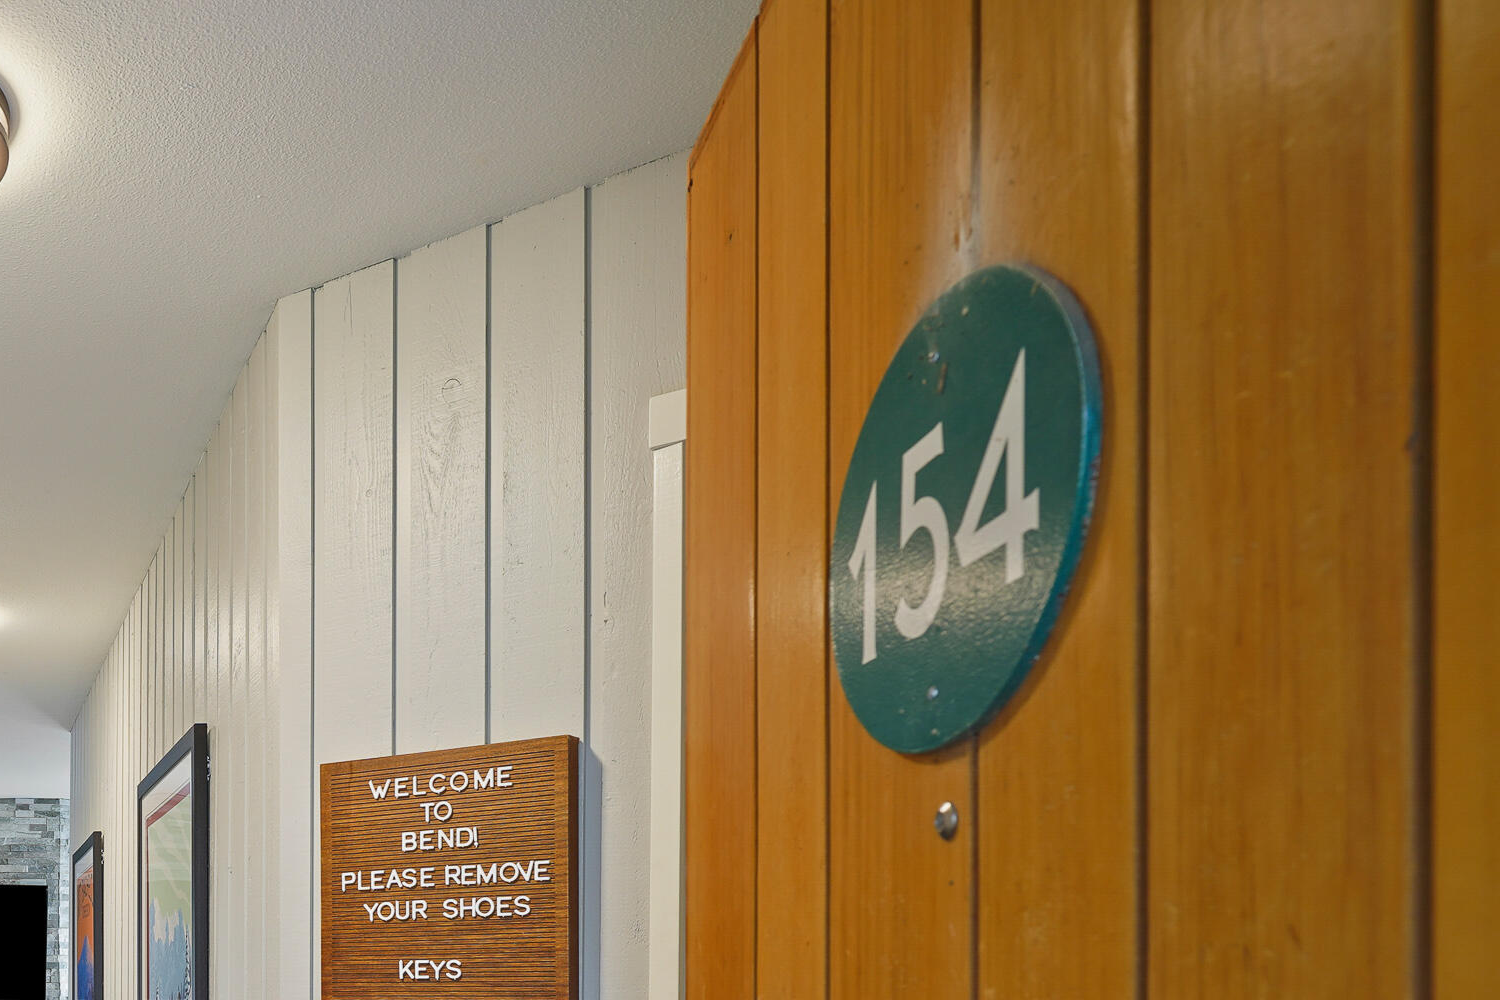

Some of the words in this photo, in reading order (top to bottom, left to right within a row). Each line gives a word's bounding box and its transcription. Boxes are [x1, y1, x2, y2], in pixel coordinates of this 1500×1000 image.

[849, 347, 1040, 665] 154
[368, 765, 514, 800] WELCOME
[419, 800, 454, 823] TO
[401, 826, 479, 852] BEND!
[341, 866, 436, 893] PLEASE
[443, 859, 551, 887] REMOVE
[363, 899, 429, 922] YOUR
[442, 895, 532, 920] SHOES
[398, 959, 463, 981] KEYS
